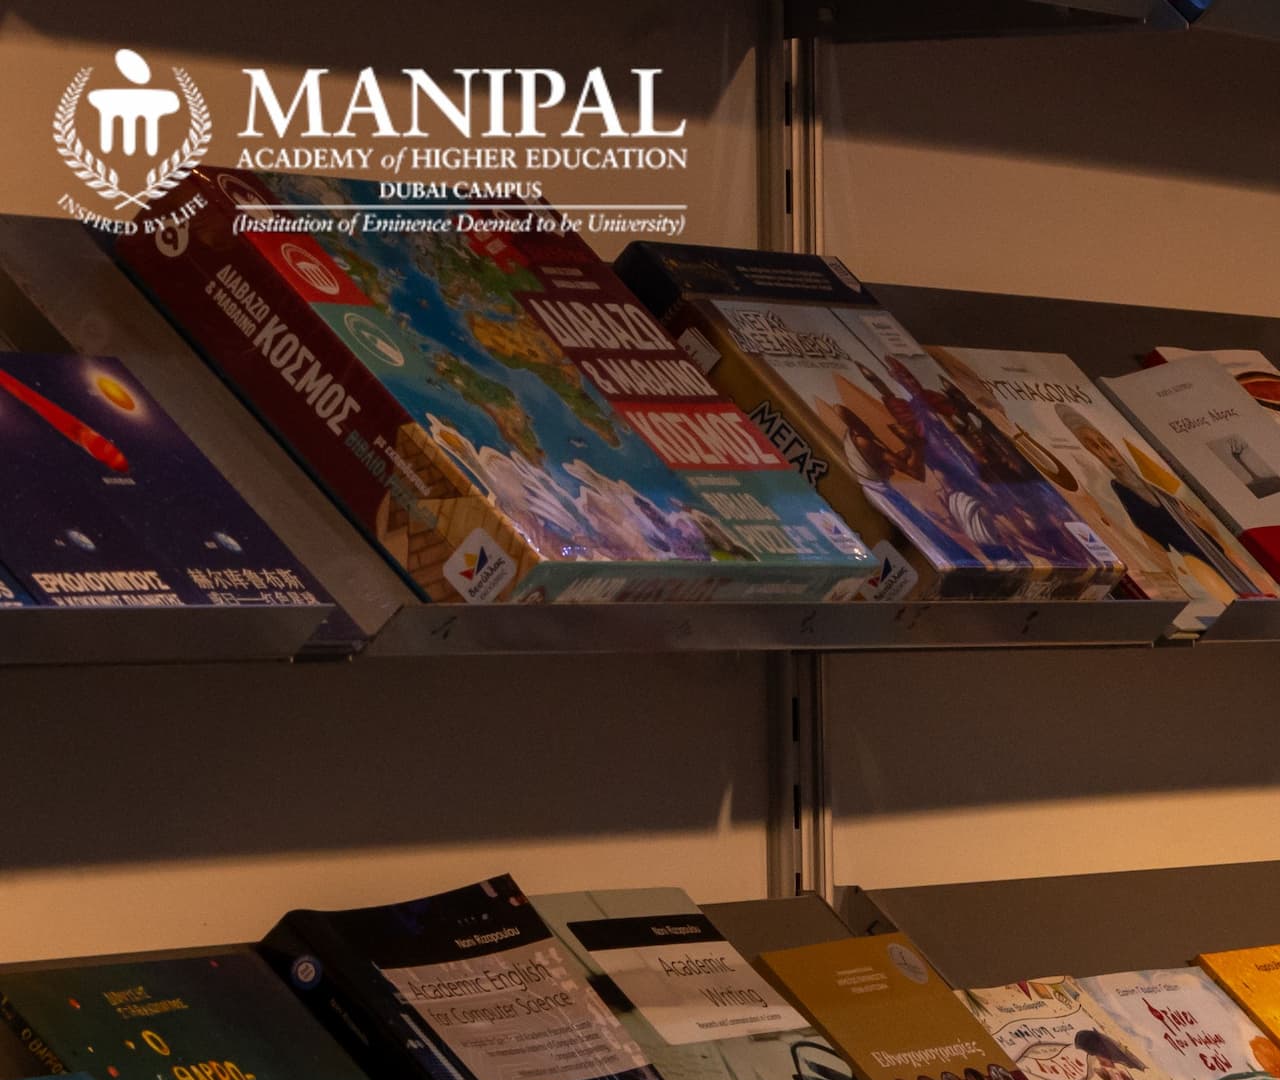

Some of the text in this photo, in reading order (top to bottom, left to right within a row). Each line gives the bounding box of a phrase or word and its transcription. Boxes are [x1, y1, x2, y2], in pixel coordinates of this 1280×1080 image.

[529, 299, 677, 352] ΔΙΑΒΑΖΩ
[252, 313, 360, 436] ΚΟΣΜΟΣ
[598, 359, 720, 397] & ΜΑΘΑΙΝΩ
[980, 376, 1094, 405] PYTHAGORAS
[627, 410, 783, 467] ΚΟΣΜΟΣ
[749, 400, 830, 486] ΜΕΓΑΣ
[408, 958, 554, 1001] Academic English
[657, 952, 737, 979] Academic
[428, 988, 574, 1029] for Computer Science
[698, 983, 770, 1010] Writing
[141, 1028, 171, 1057] Ο
